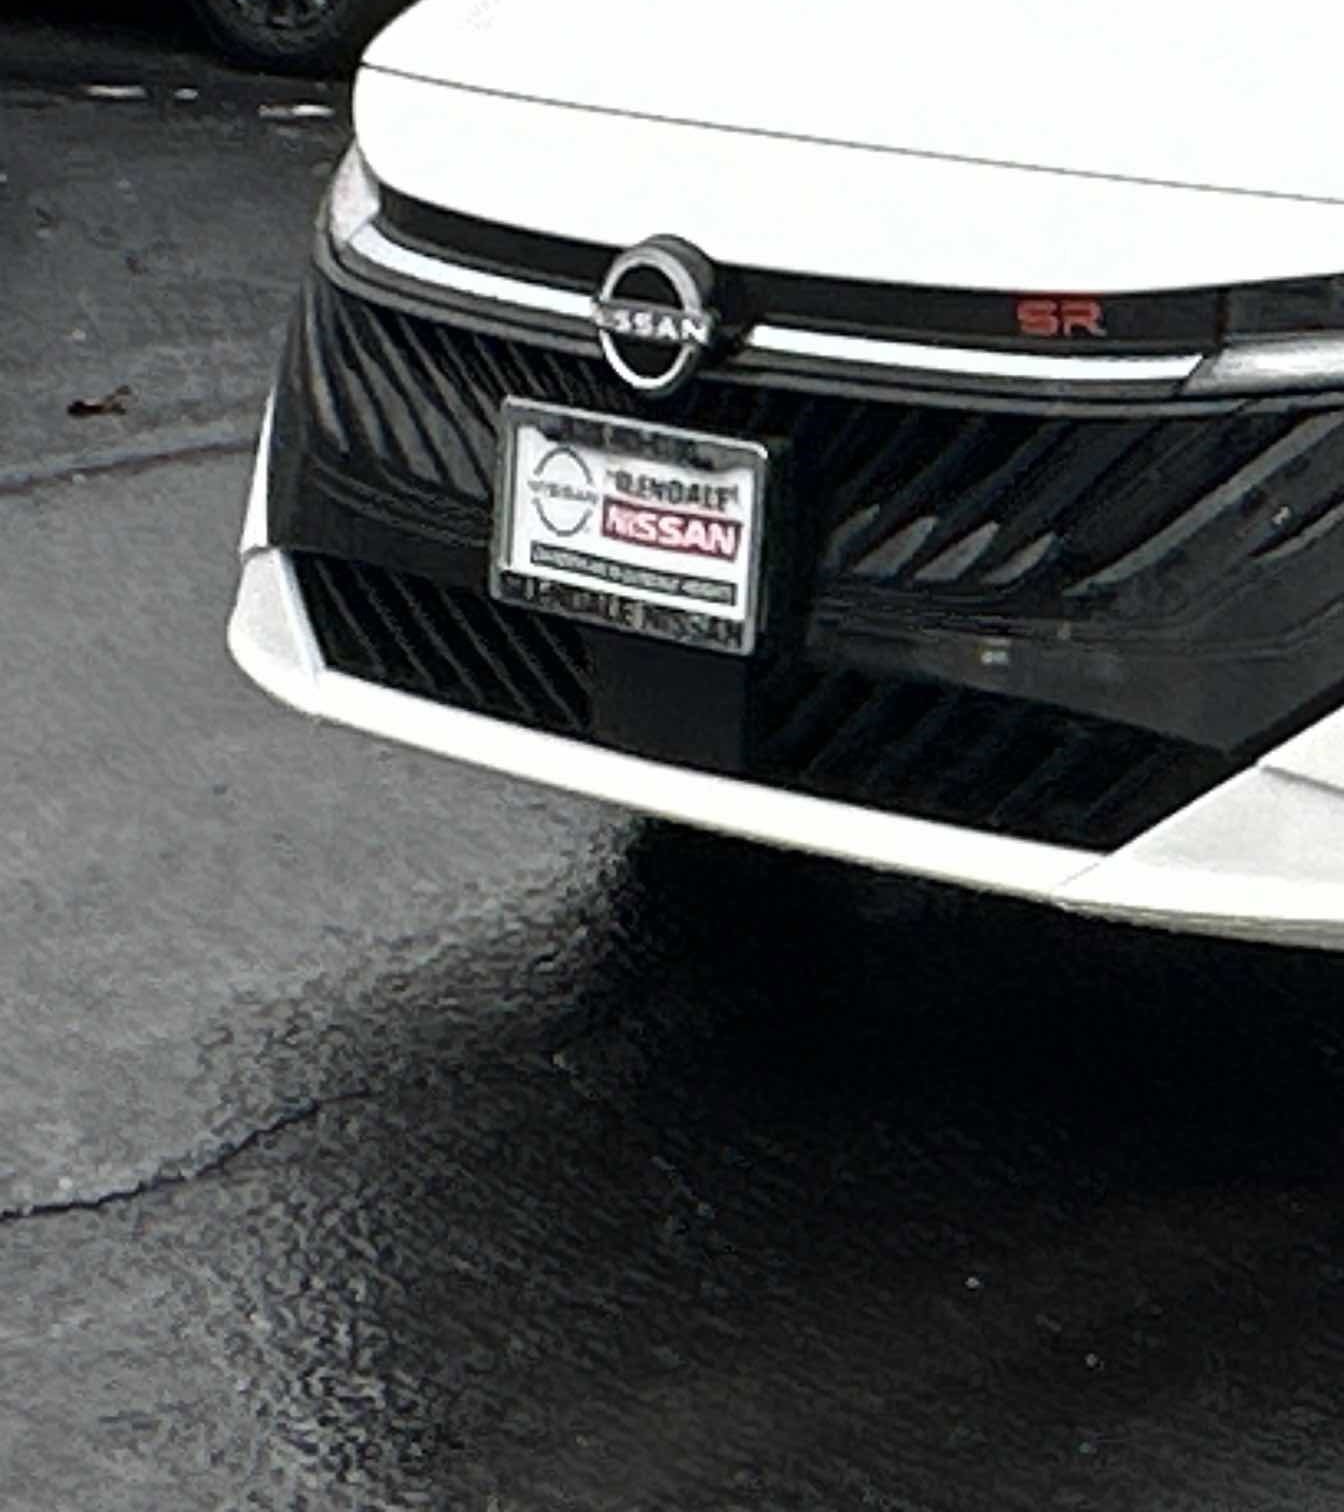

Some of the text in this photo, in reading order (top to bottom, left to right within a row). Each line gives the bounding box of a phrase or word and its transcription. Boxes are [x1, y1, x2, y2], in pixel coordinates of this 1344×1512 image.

[594, 304, 708, 343] SSAN
[1016, 299, 1107, 337] SR
[608, 504, 736, 556] NISSAN
